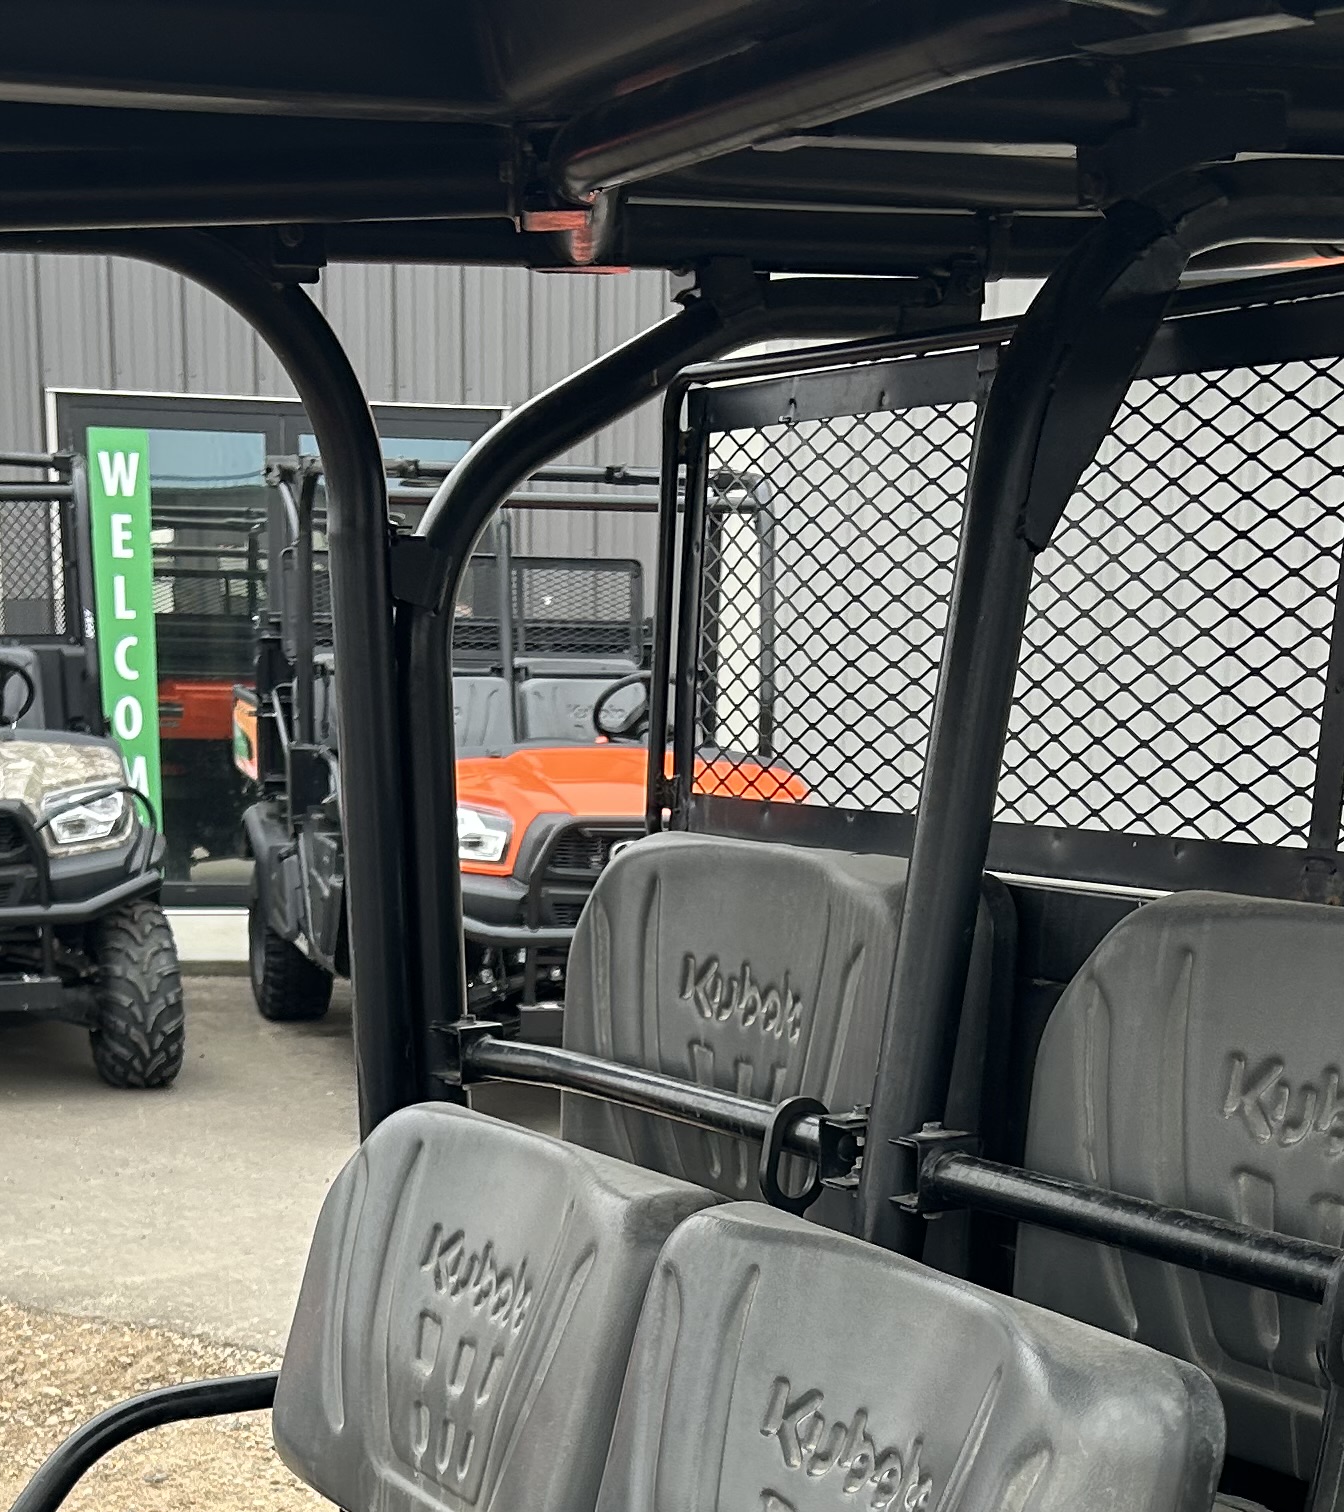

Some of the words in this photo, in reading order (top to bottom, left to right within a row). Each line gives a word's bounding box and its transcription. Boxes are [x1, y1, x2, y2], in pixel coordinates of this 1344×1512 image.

[97, 450, 150, 798] WELCOM
[679, 952, 803, 1045] Kubota
[420, 1222, 532, 1335] Kubota
